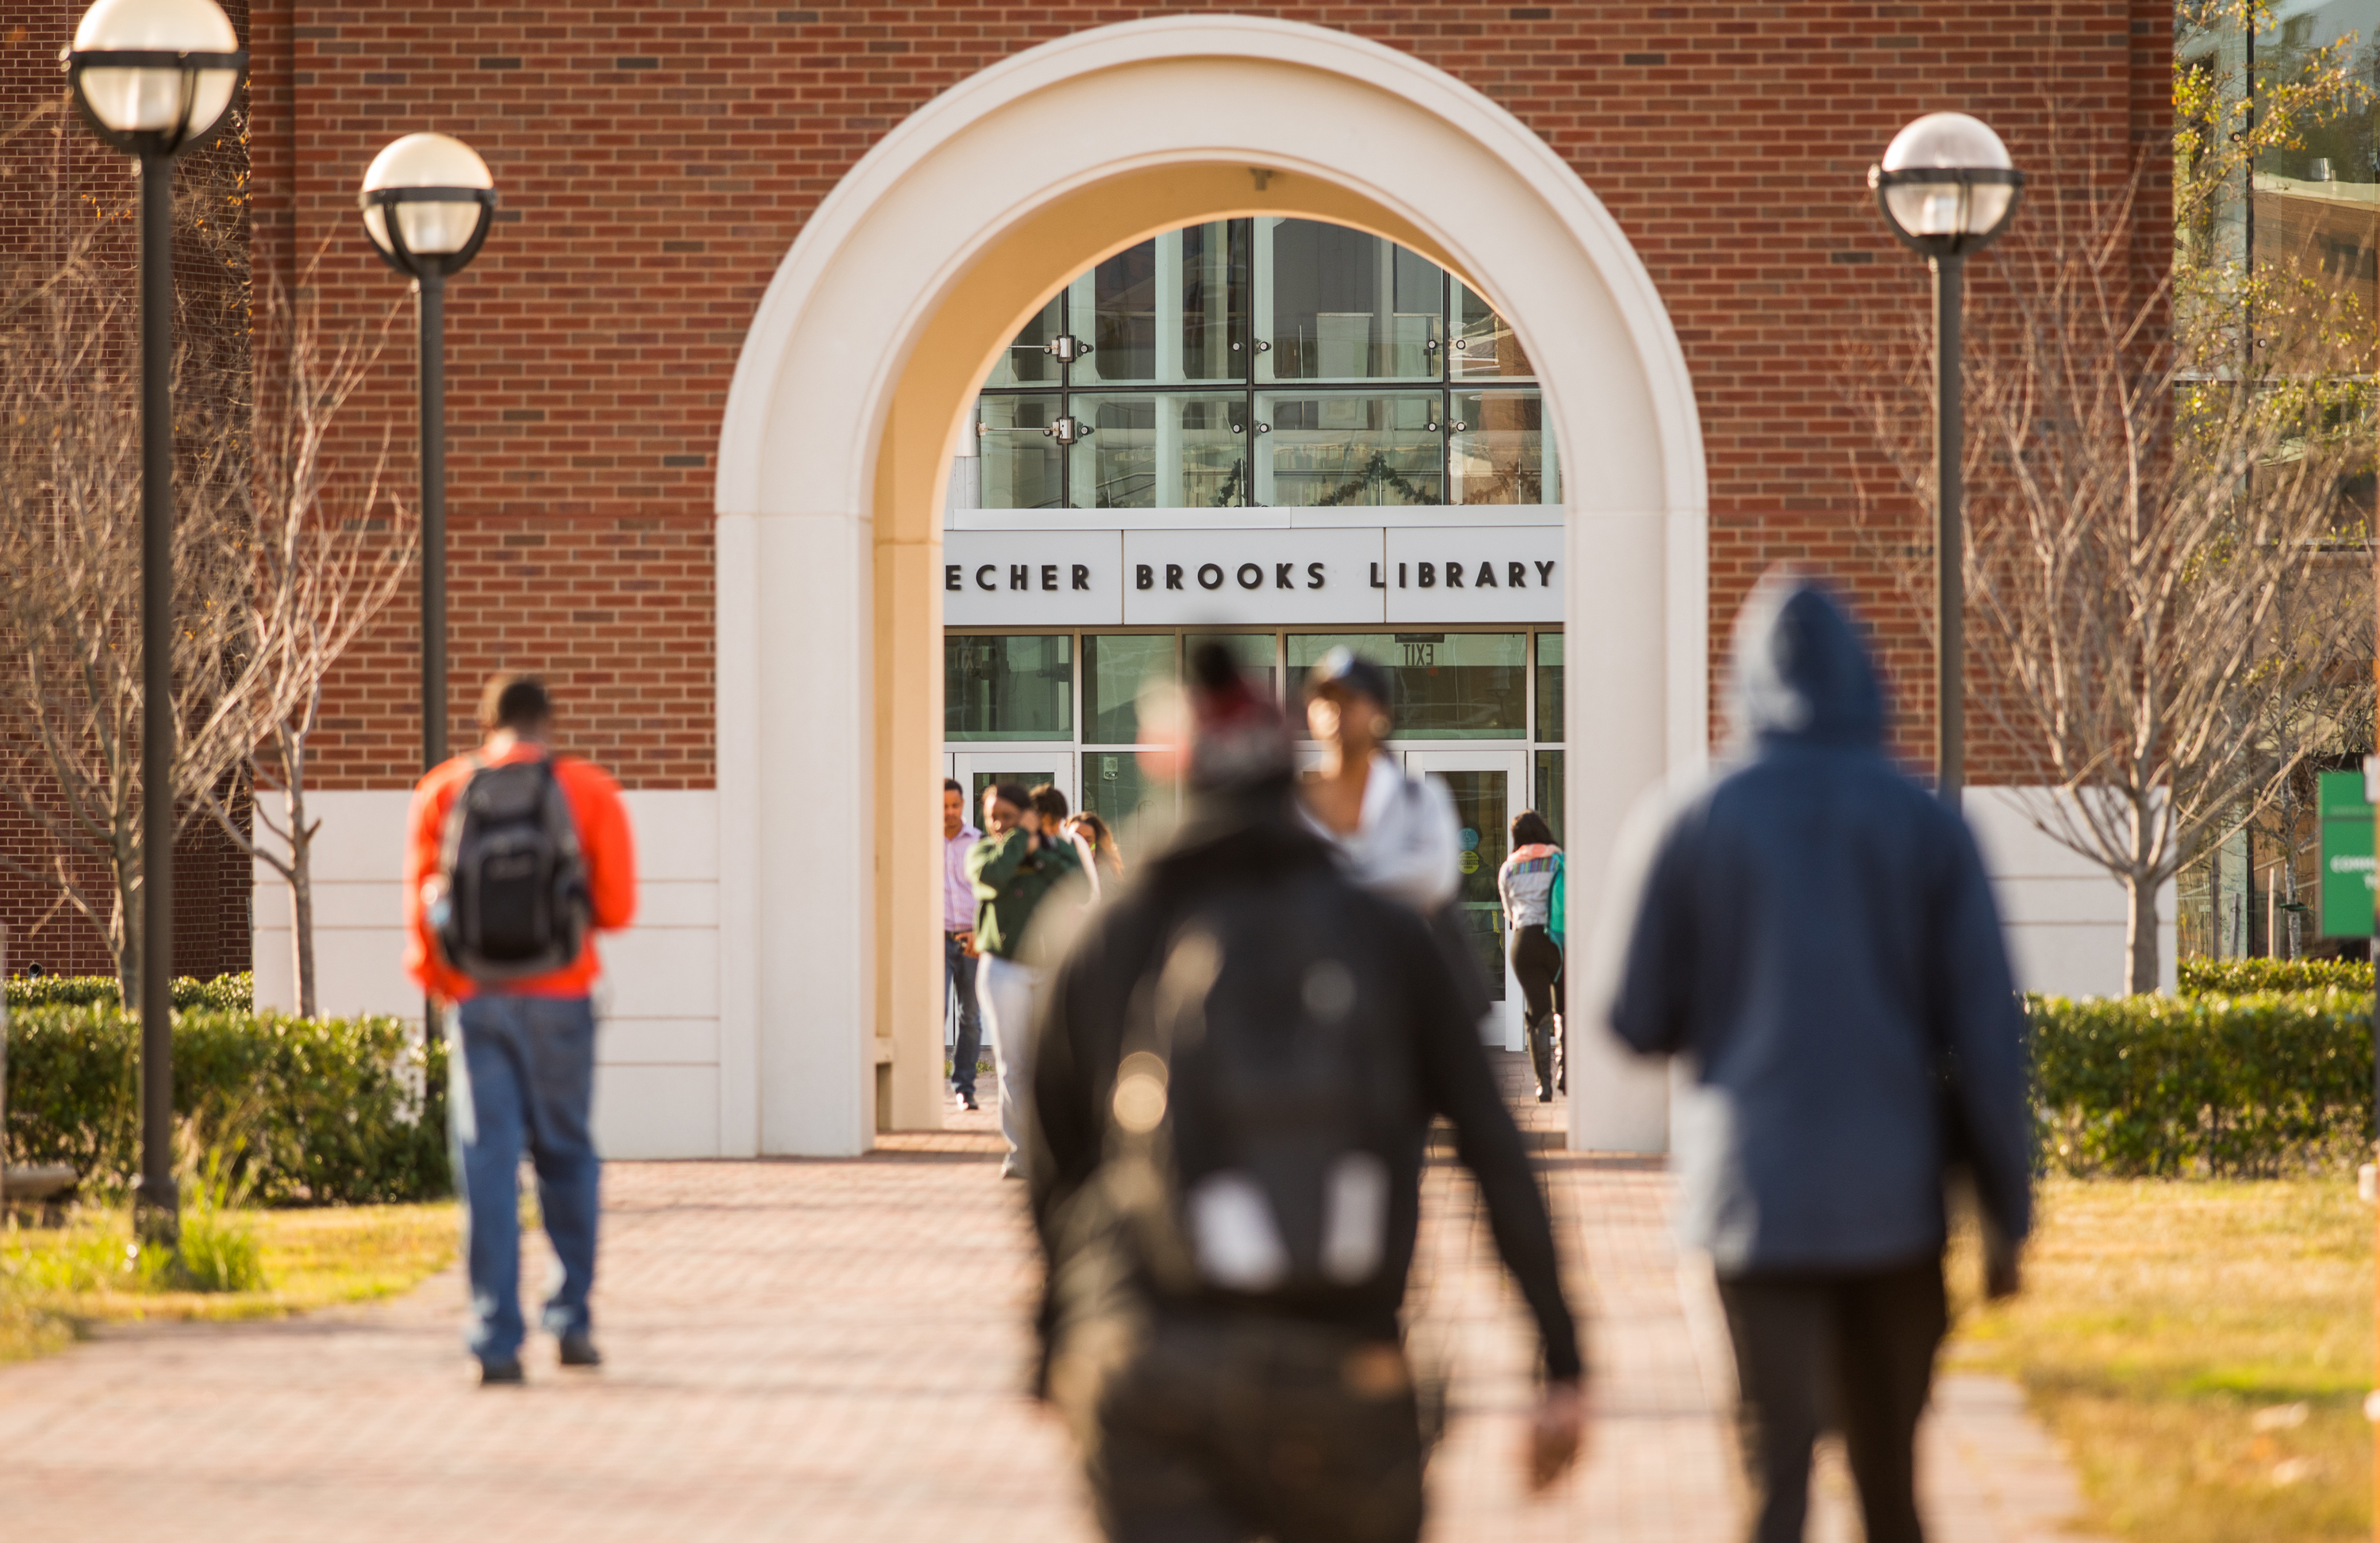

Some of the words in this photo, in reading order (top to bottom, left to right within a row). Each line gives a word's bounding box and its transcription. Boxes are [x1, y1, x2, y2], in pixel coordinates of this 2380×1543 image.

[945, 563, 1091, 591] ECHER
[1136, 562, 1326, 589] BROOKS
[1369, 560, 1555, 589] LIBRARY
